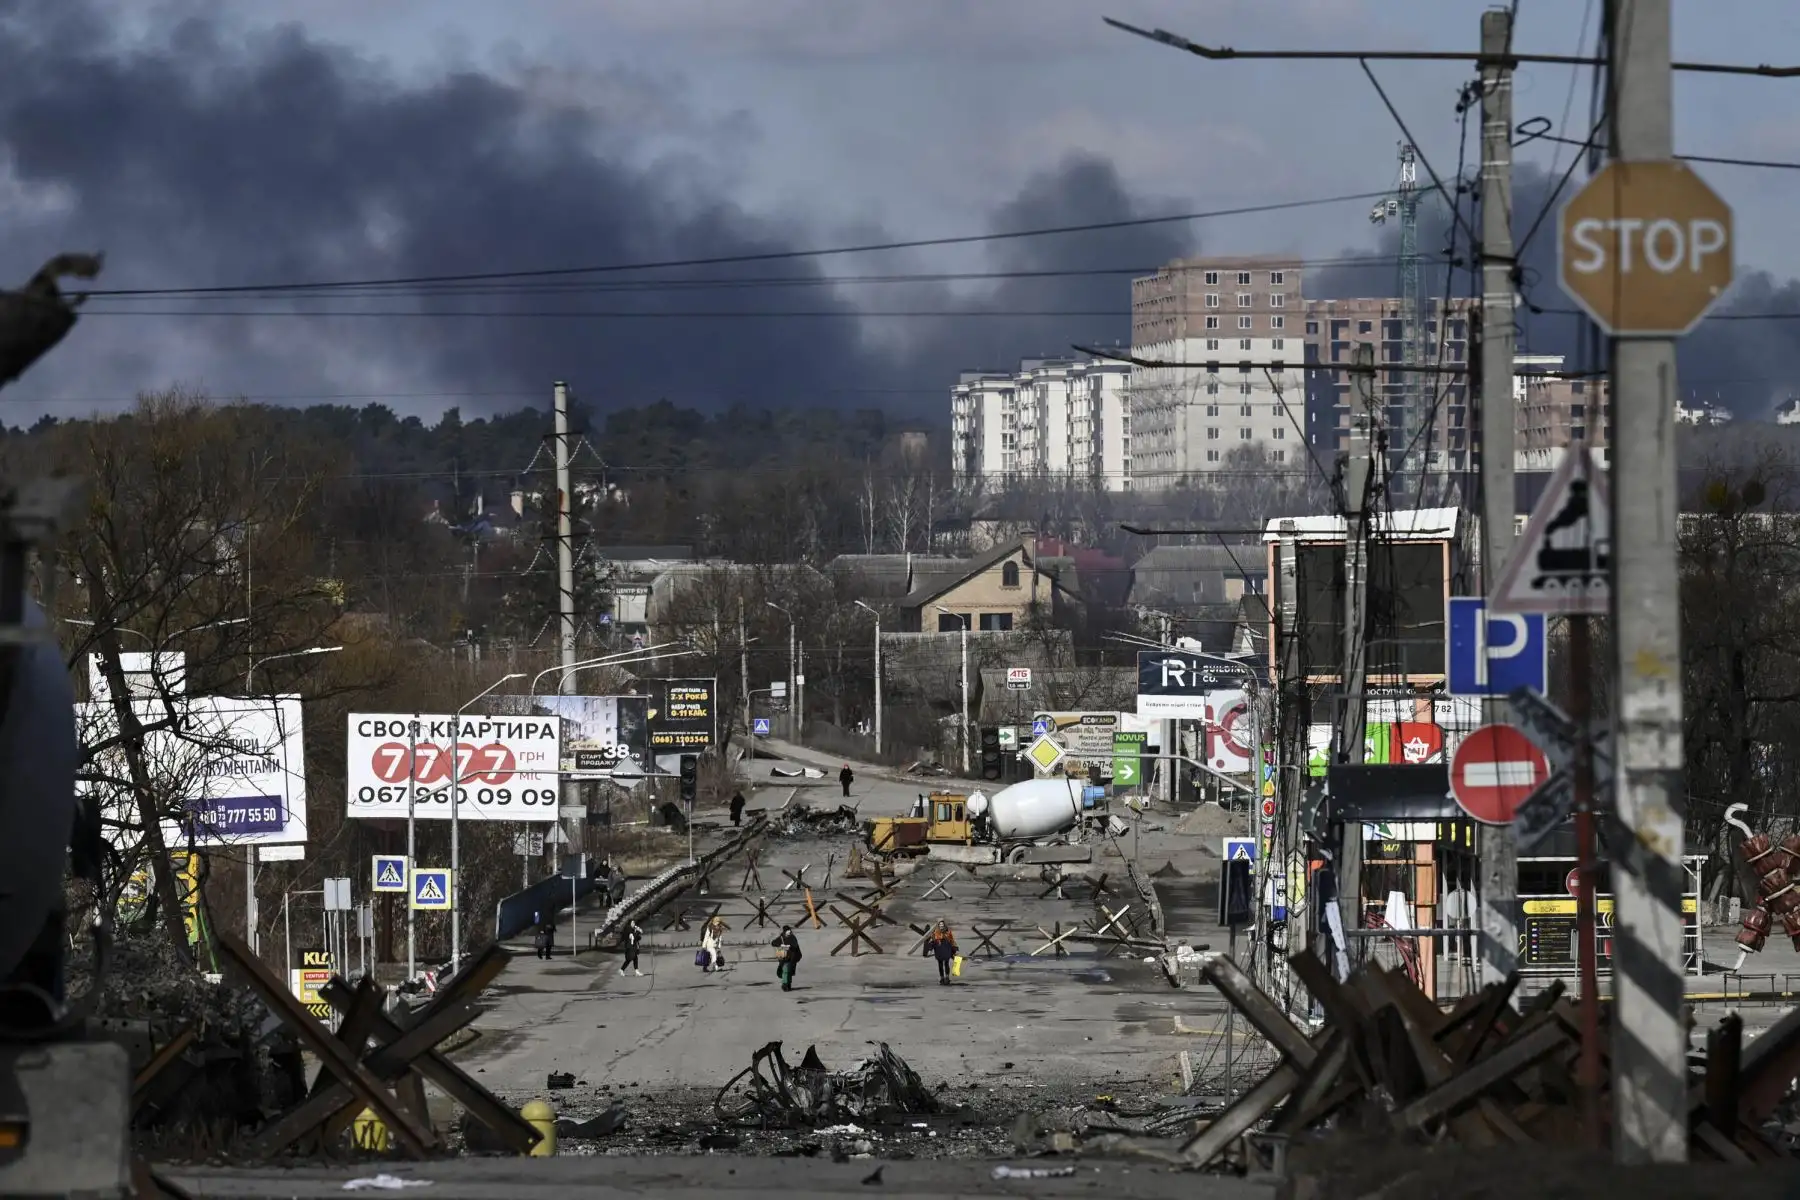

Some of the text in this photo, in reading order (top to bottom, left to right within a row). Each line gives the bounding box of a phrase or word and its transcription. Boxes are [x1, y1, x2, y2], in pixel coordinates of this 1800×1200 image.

[1571, 217, 1726, 272] STOP
[1475, 607, 1528, 686] P
[1161, 659, 1187, 686] R
[357, 720, 421, 738] СВОЯ
[1115, 733, 1145, 741] NOVUS
[358, 786, 408, 804] 067
[477, 788, 512, 806] 09
[521, 789, 556, 807] 09
[227, 808, 246, 824] 777
[248, 808, 262, 823] 55
[263, 807, 277, 822] 50
